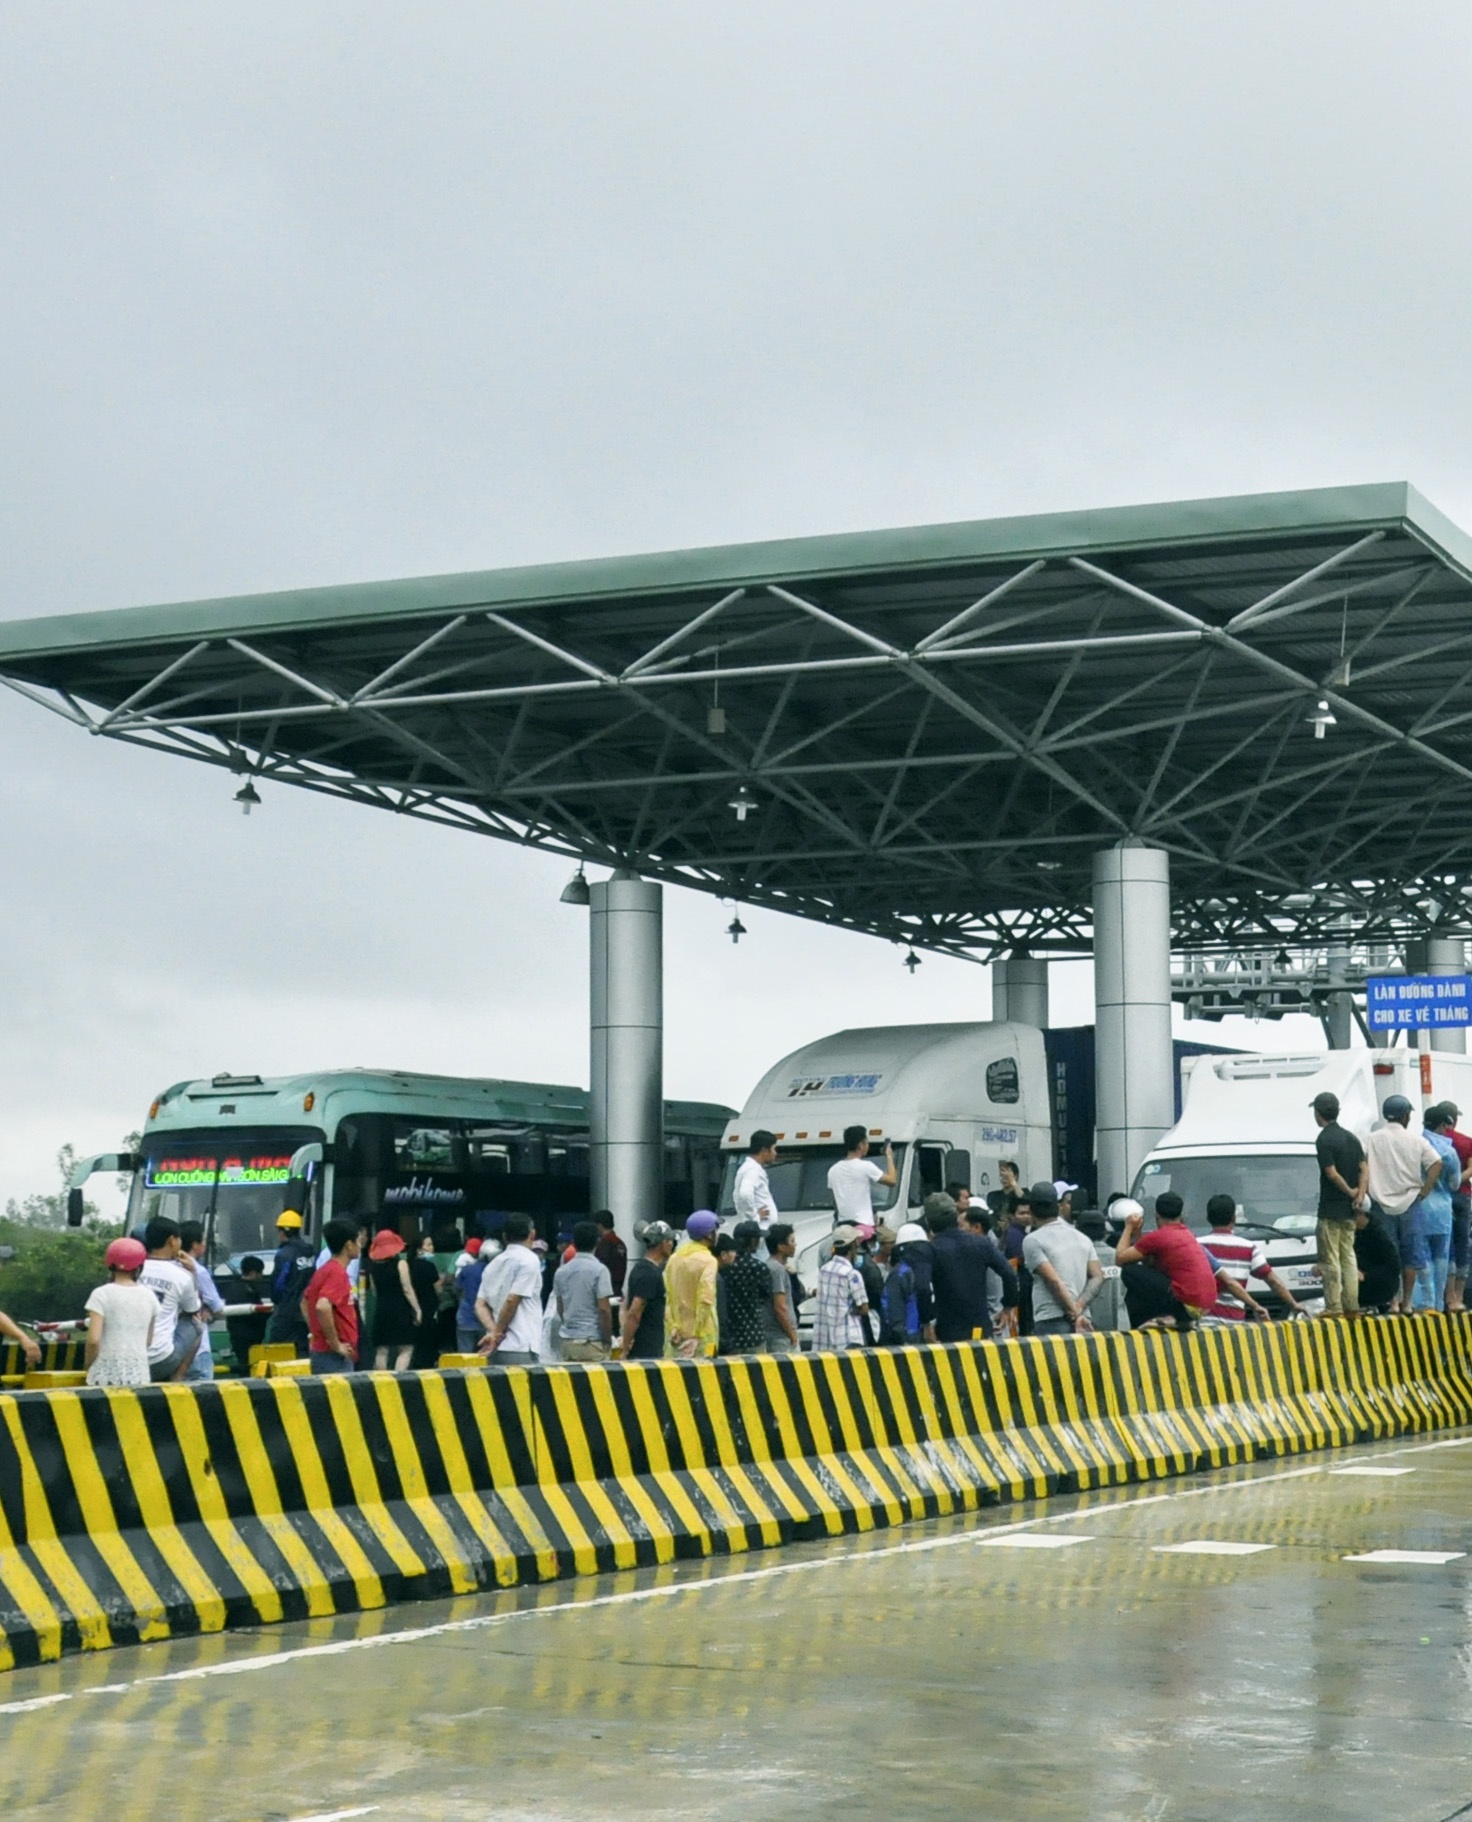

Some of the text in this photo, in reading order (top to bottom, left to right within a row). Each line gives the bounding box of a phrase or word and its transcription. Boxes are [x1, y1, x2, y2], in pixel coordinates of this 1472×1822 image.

[1374, 983, 1396, 1000] LÀN
[1437, 982, 1466, 998] DÀNH
[1374, 1009, 1395, 1024] CHO
[1398, 1008, 1412, 1022] XE
[1433, 1004, 1469, 1022] THÁNG
